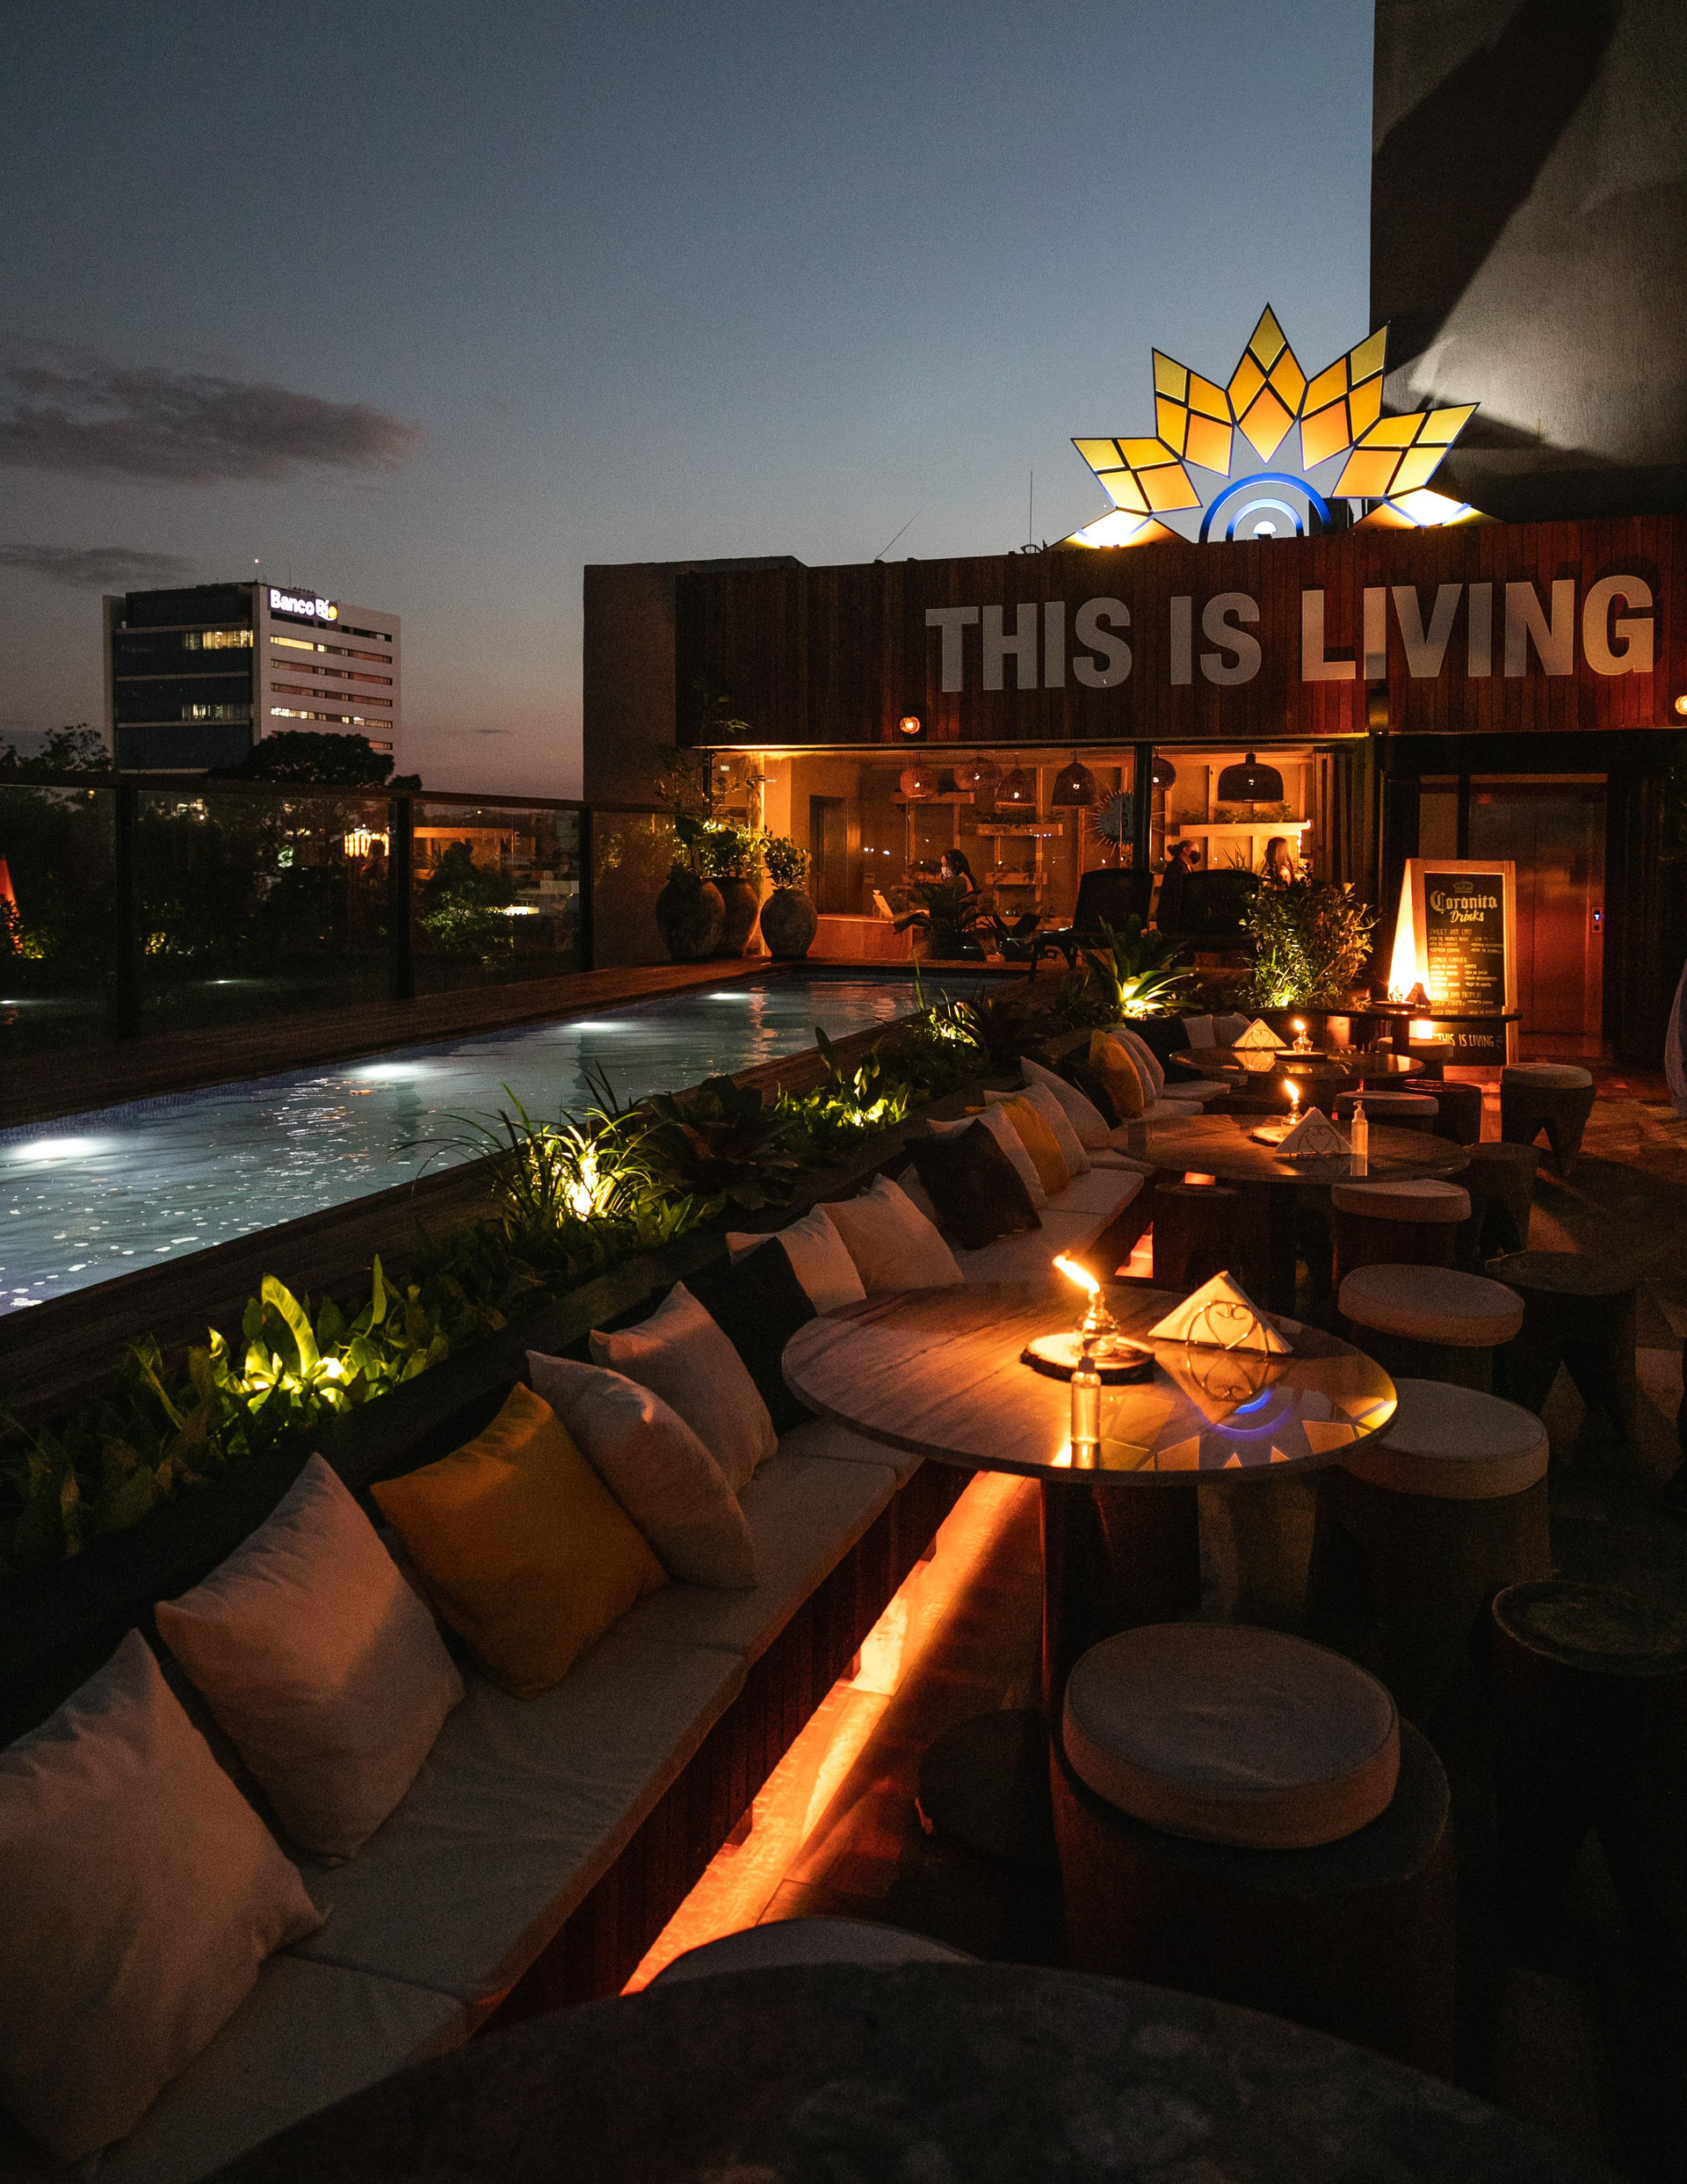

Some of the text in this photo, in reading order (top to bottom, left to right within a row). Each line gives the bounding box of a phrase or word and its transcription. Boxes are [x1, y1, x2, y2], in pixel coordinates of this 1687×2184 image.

[270, 589, 338, 621] Banco Río
[924, 575, 1655, 693] THIS IS LIVING
[1430, 890, 1498, 914] Coronita
[1450, 910, 1485, 923] Drinks
[1459, 1034, 1467, 1047] IS
[1468, 1034, 1495, 1048] LIVING
